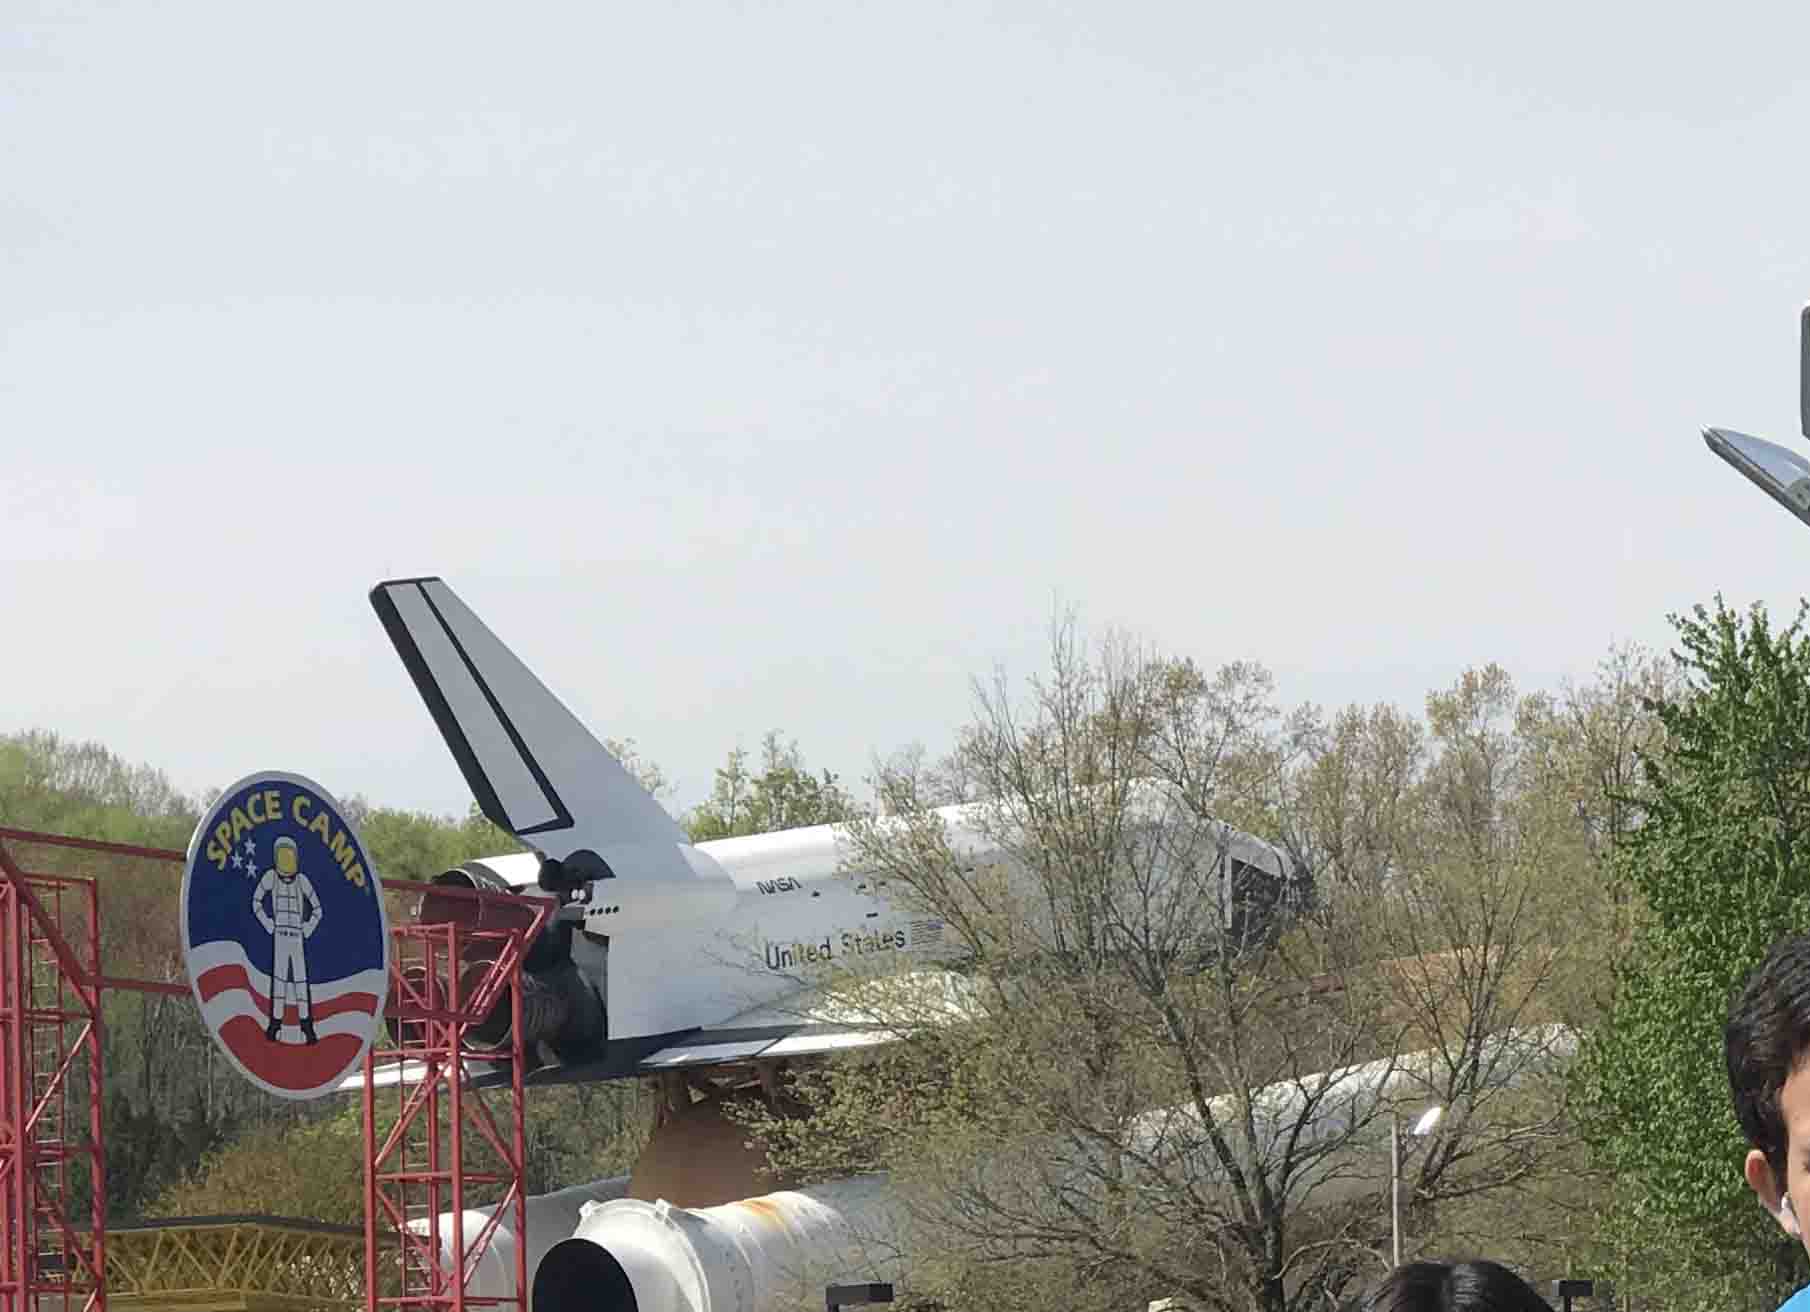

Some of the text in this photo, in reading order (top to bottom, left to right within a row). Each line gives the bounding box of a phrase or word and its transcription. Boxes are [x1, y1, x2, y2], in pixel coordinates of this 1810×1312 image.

[206, 789, 367, 888] SPACE CAMP
[756, 876, 803, 895] NASA
[765, 930, 905, 970] United States
